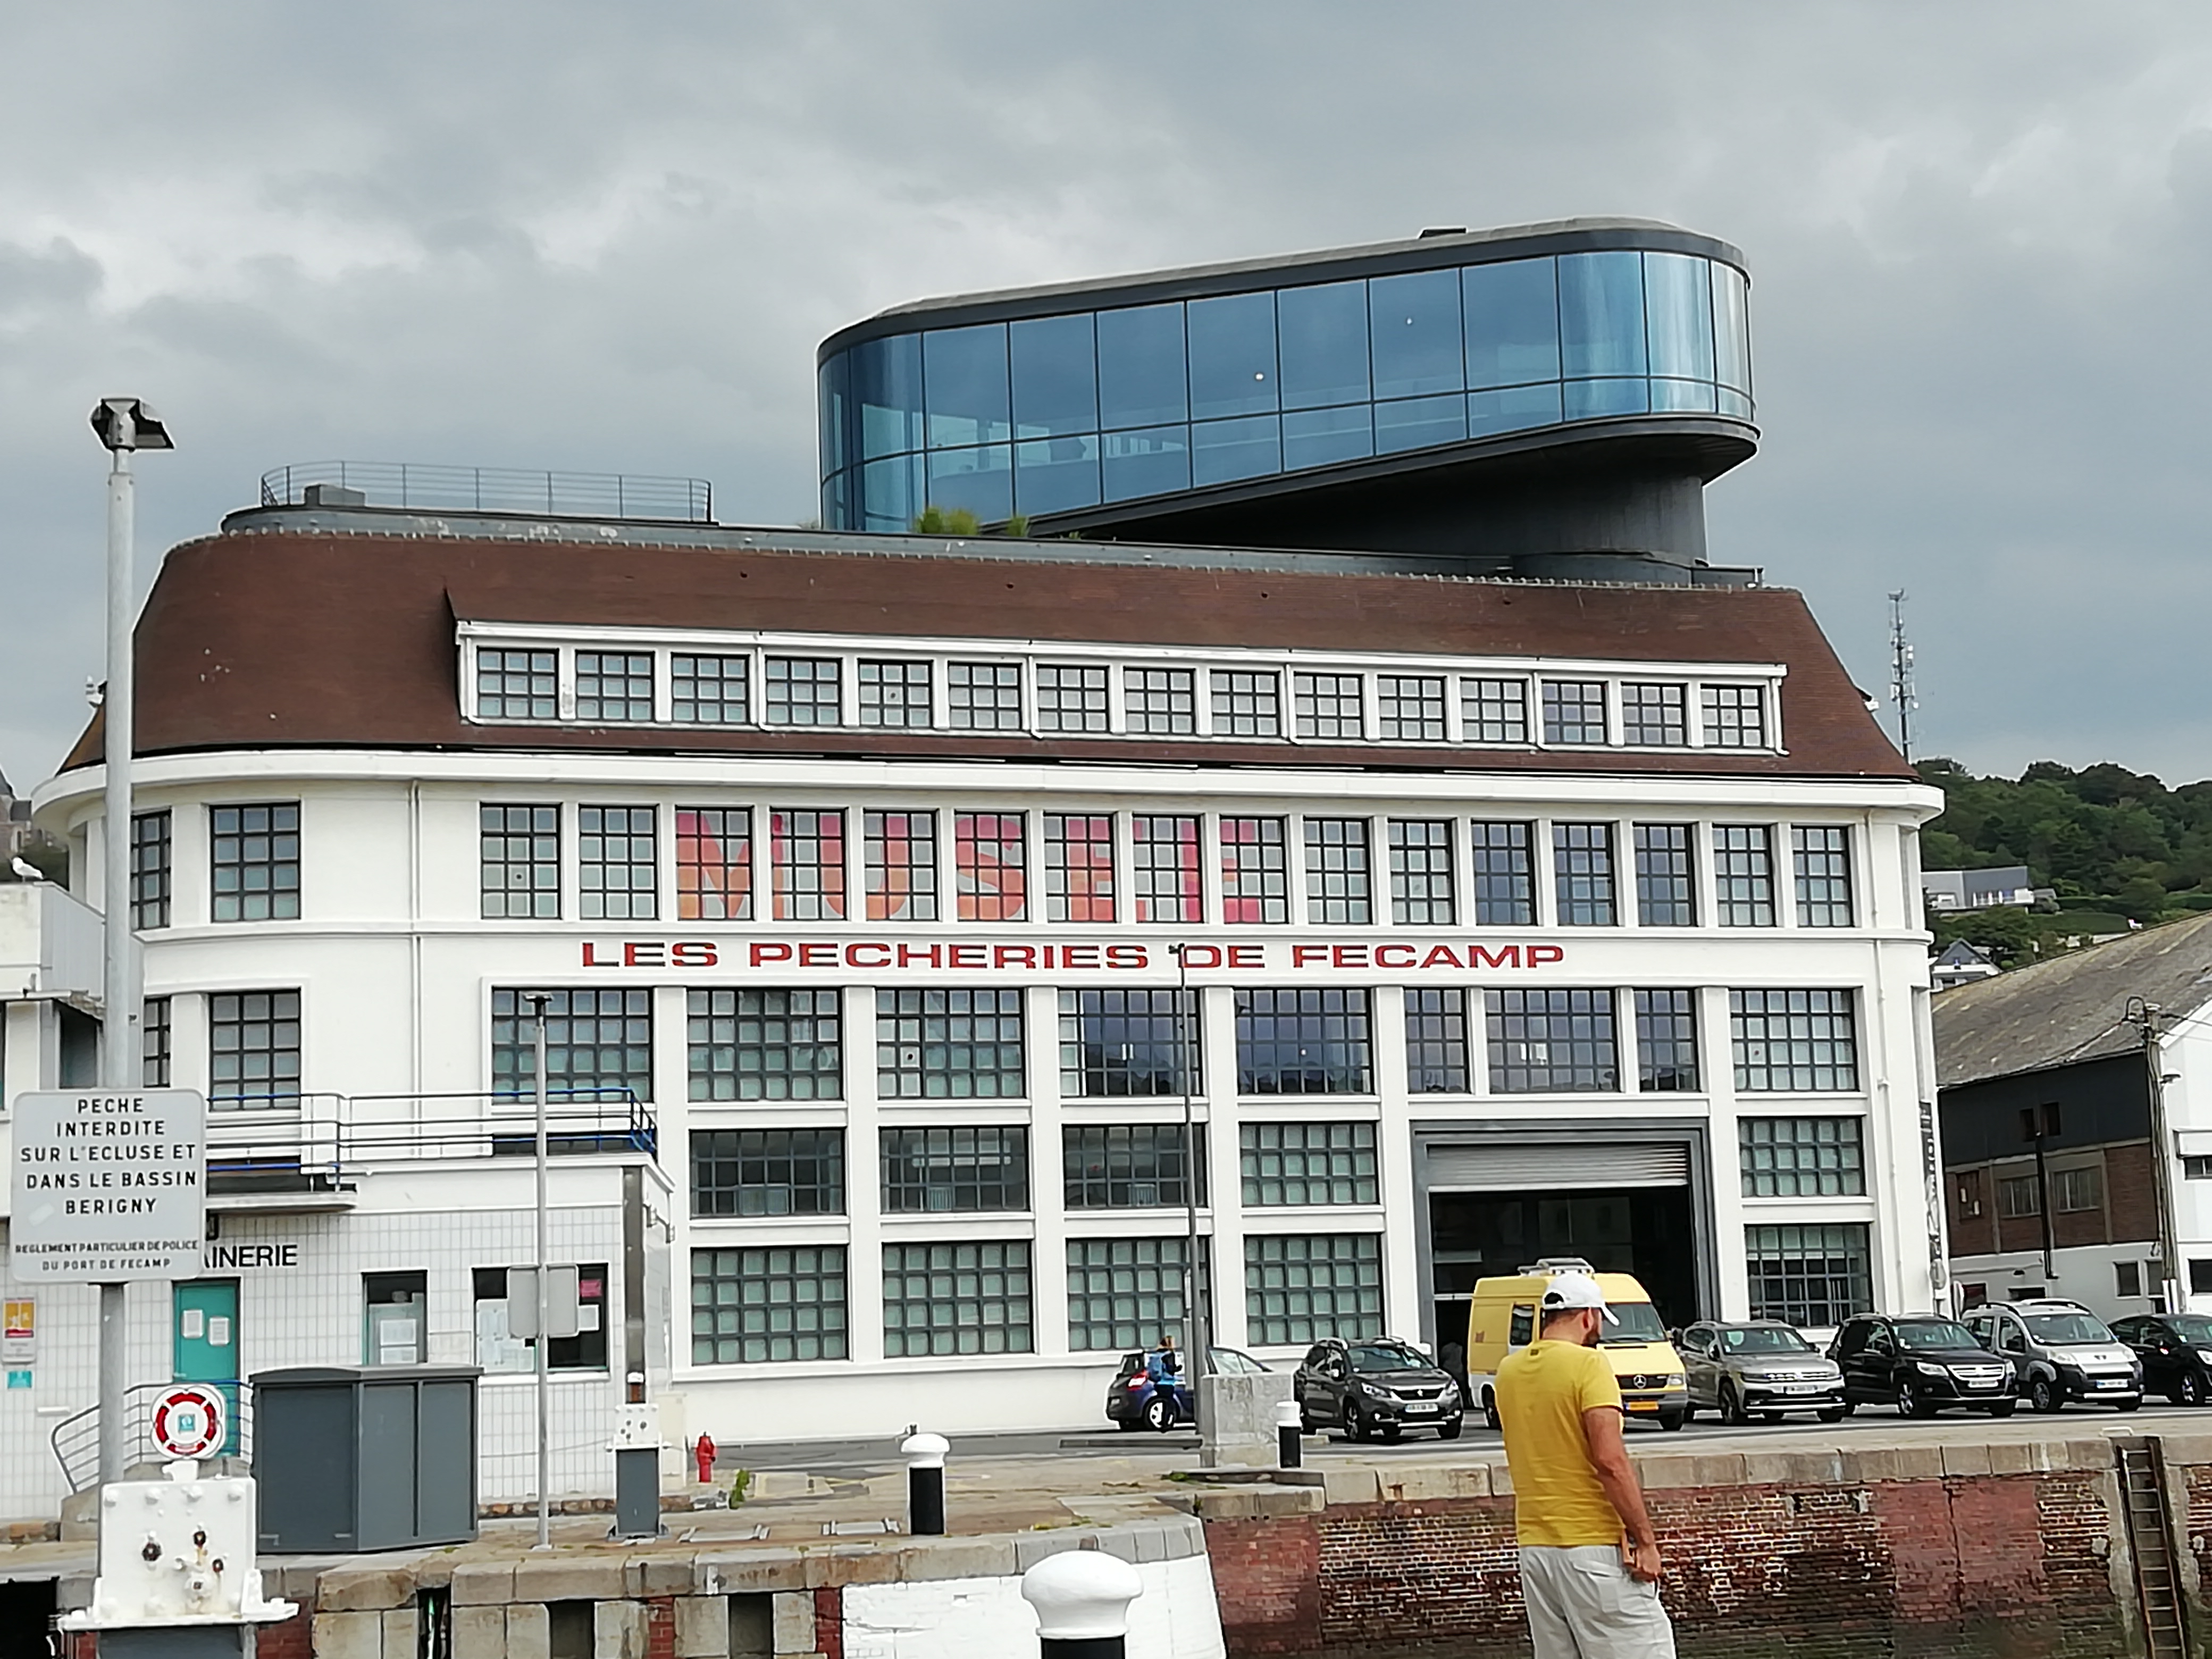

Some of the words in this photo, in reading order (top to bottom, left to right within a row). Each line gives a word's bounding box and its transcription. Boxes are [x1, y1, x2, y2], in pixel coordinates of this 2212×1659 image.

[582, 942, 718, 967] LES
[749, 943, 1148, 969] PECHERIES
[1179, 945, 1266, 968] DE
[1292, 944, 1563, 968] FECAMP
[78, 1098, 144, 1114] PECHE
[57, 1120, 165, 1138] INTERDITE
[21, 1147, 61, 1162] SUR
[70, 1145, 164, 1162] L'ECLUSE
[173, 1144, 195, 1160] ET
[27, 1174, 80, 1189] DANS
[90, 1172, 112, 1188] LE
[122, 1171, 196, 1187] BASSIN
[66, 1199, 156, 1214] BERIGNY
[15, 1243, 77, 1254] REGLEMENT
[79, 1241, 145, 1252] PARTICULIER
[147, 1241, 161, 1251] DE
[162, 1239, 198, 1251] POLICE
[43, 1261, 58, 1271] DU
[63, 1260, 95, 1271] PORT
[100, 1259, 115, 1269] DE
[120, 1258, 171, 1268] FECAMP
